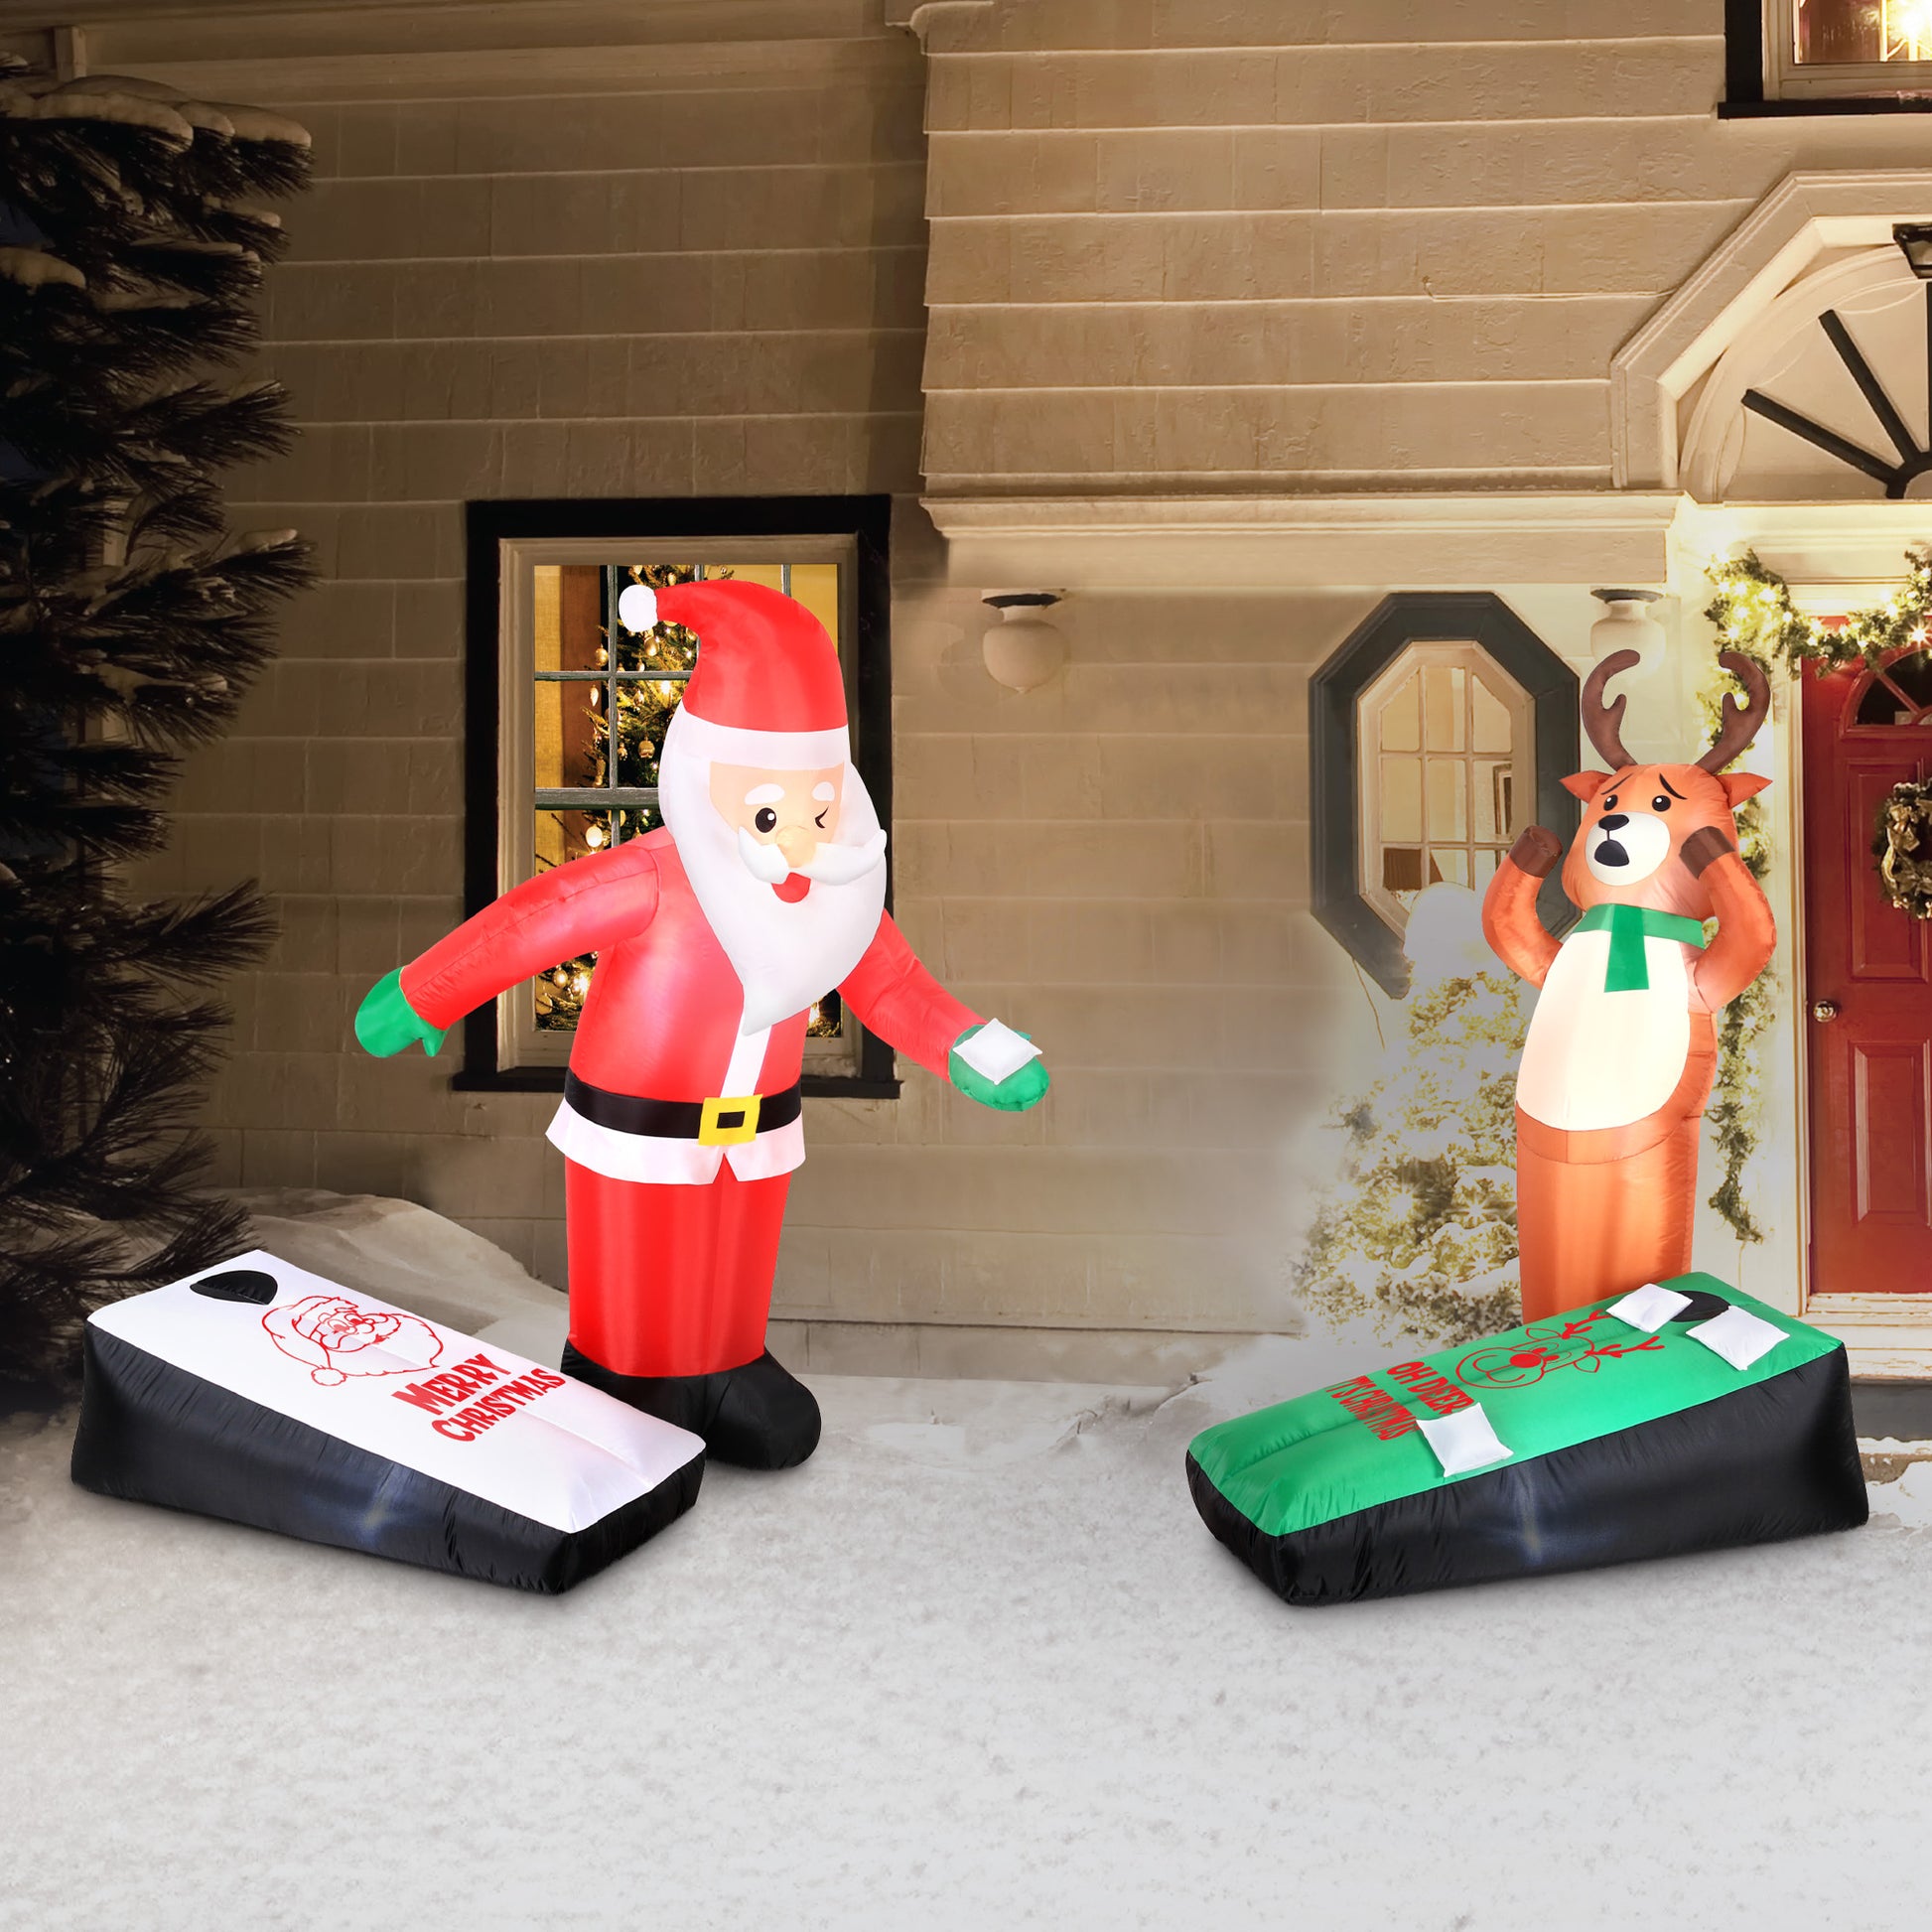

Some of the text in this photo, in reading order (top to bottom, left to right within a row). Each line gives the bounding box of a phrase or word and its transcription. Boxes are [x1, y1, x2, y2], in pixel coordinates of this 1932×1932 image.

[391, 1353, 511, 1416] MERRY
[431, 1368, 566, 1442] CHRISTMAS
[1386, 1361, 1474, 1415] OH DEER
[1338, 1389, 1420, 1441] CHRISTMAS
